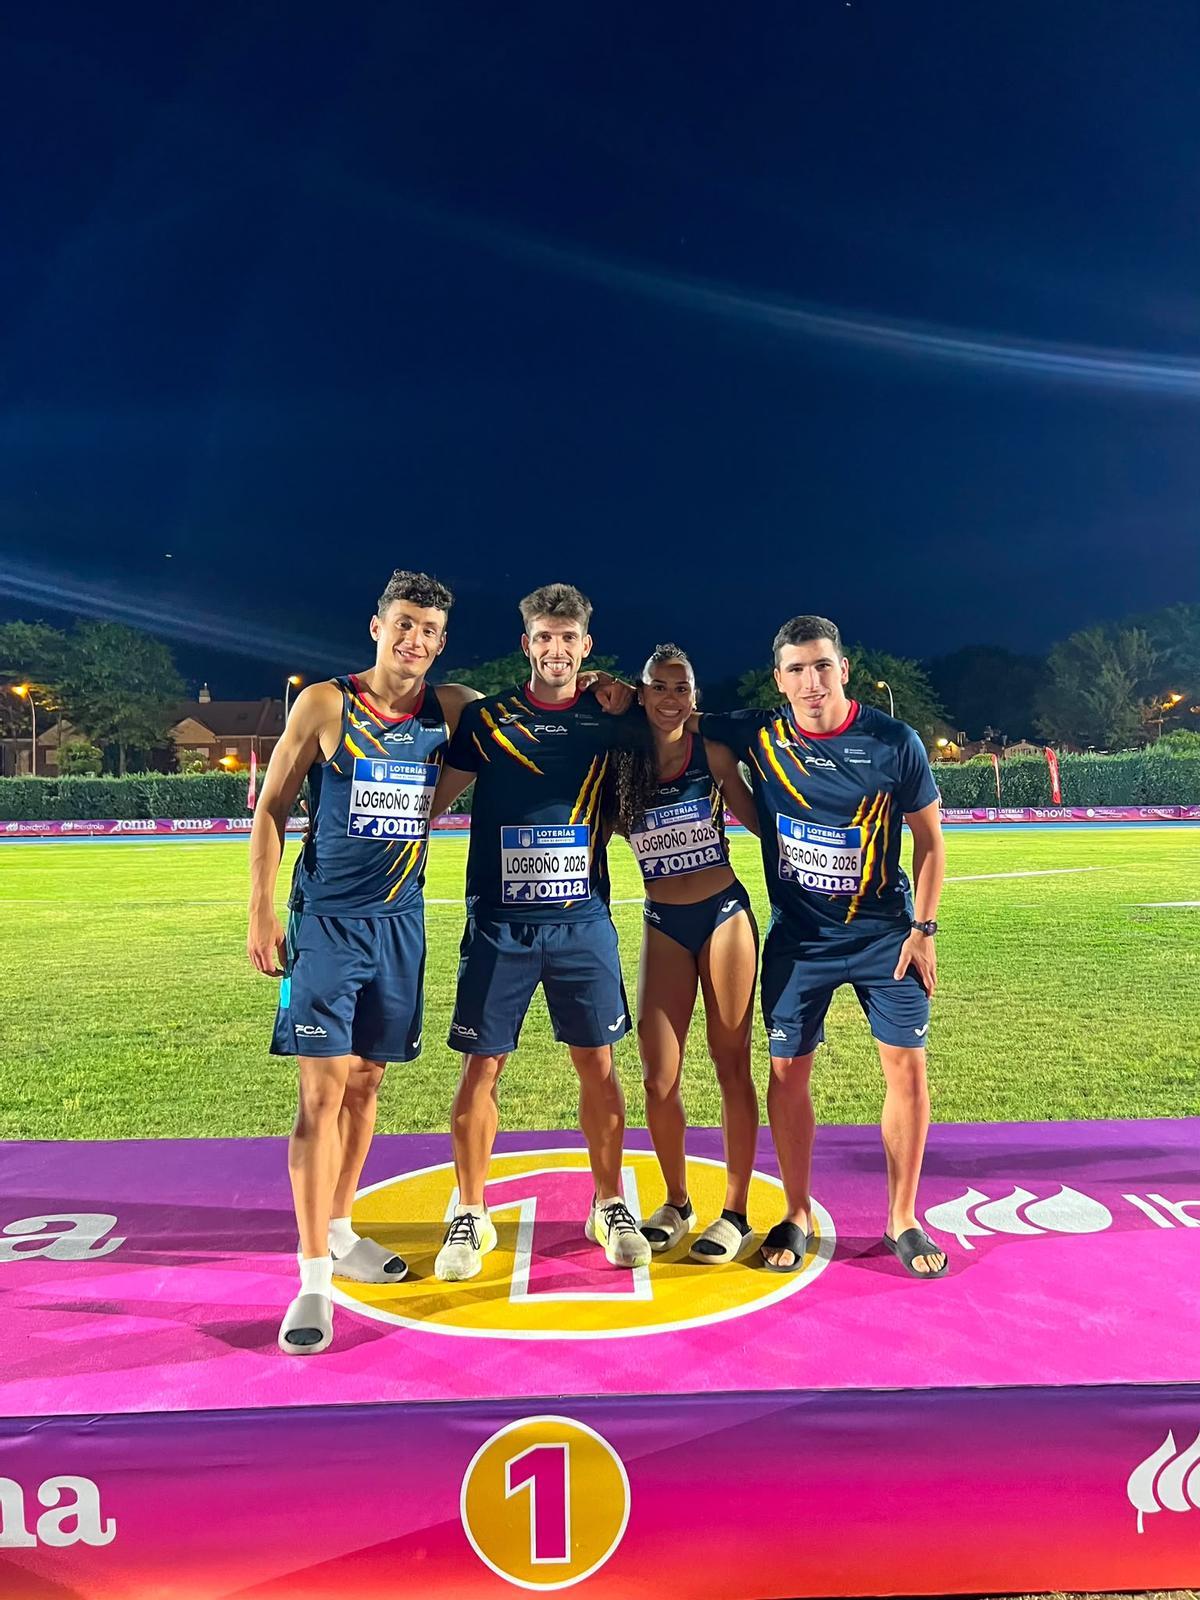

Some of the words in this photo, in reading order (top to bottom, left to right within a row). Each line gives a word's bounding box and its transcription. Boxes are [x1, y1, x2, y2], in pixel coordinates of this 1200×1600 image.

[534, 725, 568, 733] FCA
[384, 733, 414, 742] FCA
[805, 756, 836, 768] FCA
[390, 765, 427, 775] LOTERÍAS
[355, 788, 410, 811] LOGROÑO
[660, 804, 698, 818] LOTERÍAS
[1035, 808, 1073, 818] enovis
[170, 819, 213, 832] Joma
[371, 817, 426, 837] Joma
[536, 828, 576, 837] LOTERÍAS
[806, 827, 846, 839] LOTERÍAS
[636, 828, 687, 854] LOGROÑO
[690, 827, 716, 843] 2026
[506, 852, 560, 874] LOGROÑO
[563, 855, 586, 873] 2026
[660, 847, 721, 875] Joma
[832, 855, 857, 871] 2026
[524, 880, 587, 900] Joma
[295, 1024, 328, 1035] FCA
[452, 1023, 478, 1036] FCA
[444, 1166, 654, 1304] 1
[504, 1441, 571, 1565] 1
